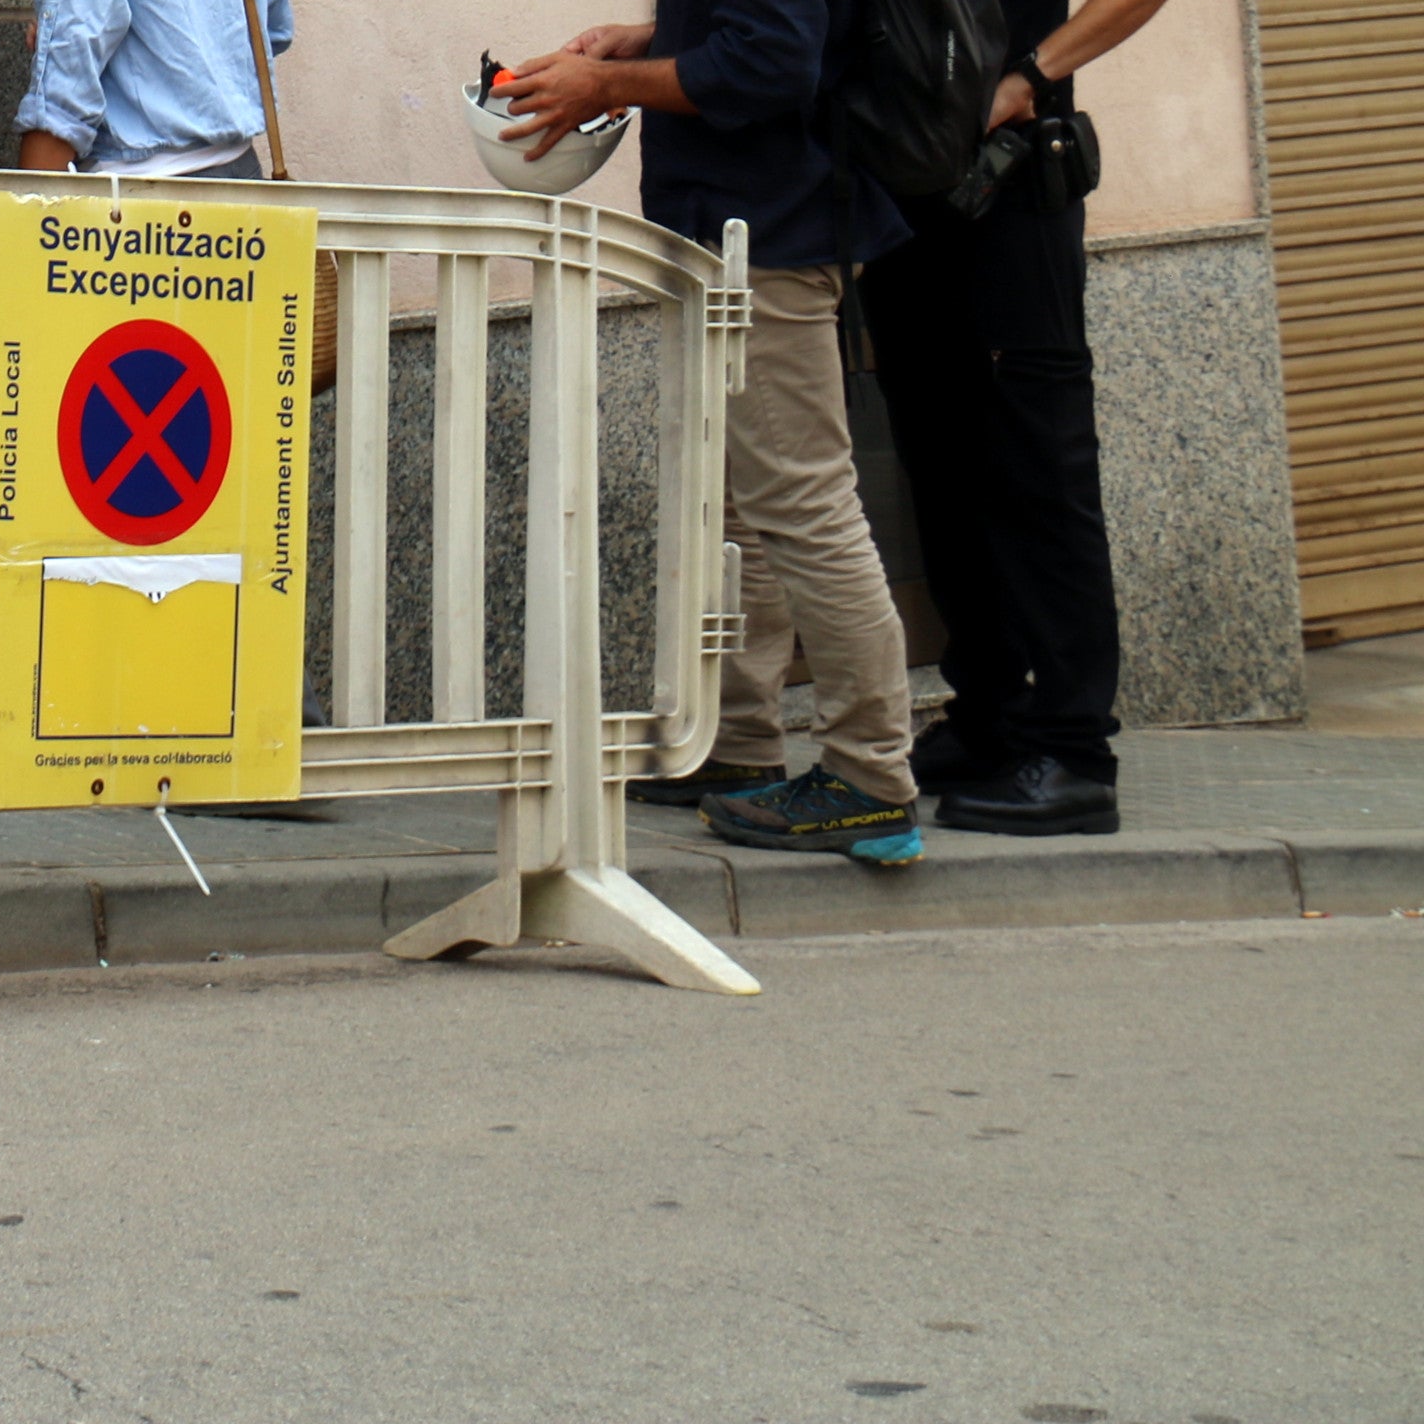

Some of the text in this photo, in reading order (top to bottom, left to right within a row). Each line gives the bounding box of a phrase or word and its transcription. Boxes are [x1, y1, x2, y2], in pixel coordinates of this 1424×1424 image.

[39, 216, 266, 261] Senyalització
[47, 260, 254, 305] Excepcional
[2, 341, 21, 416] Local
[271, 293, 298, 595] Ajuntament de Sallent
[35, 753, 81, 766] Gràcies
[84, 754, 103, 768] per
[108, 752, 118, 765] la
[122, 754, 150, 765] seva
